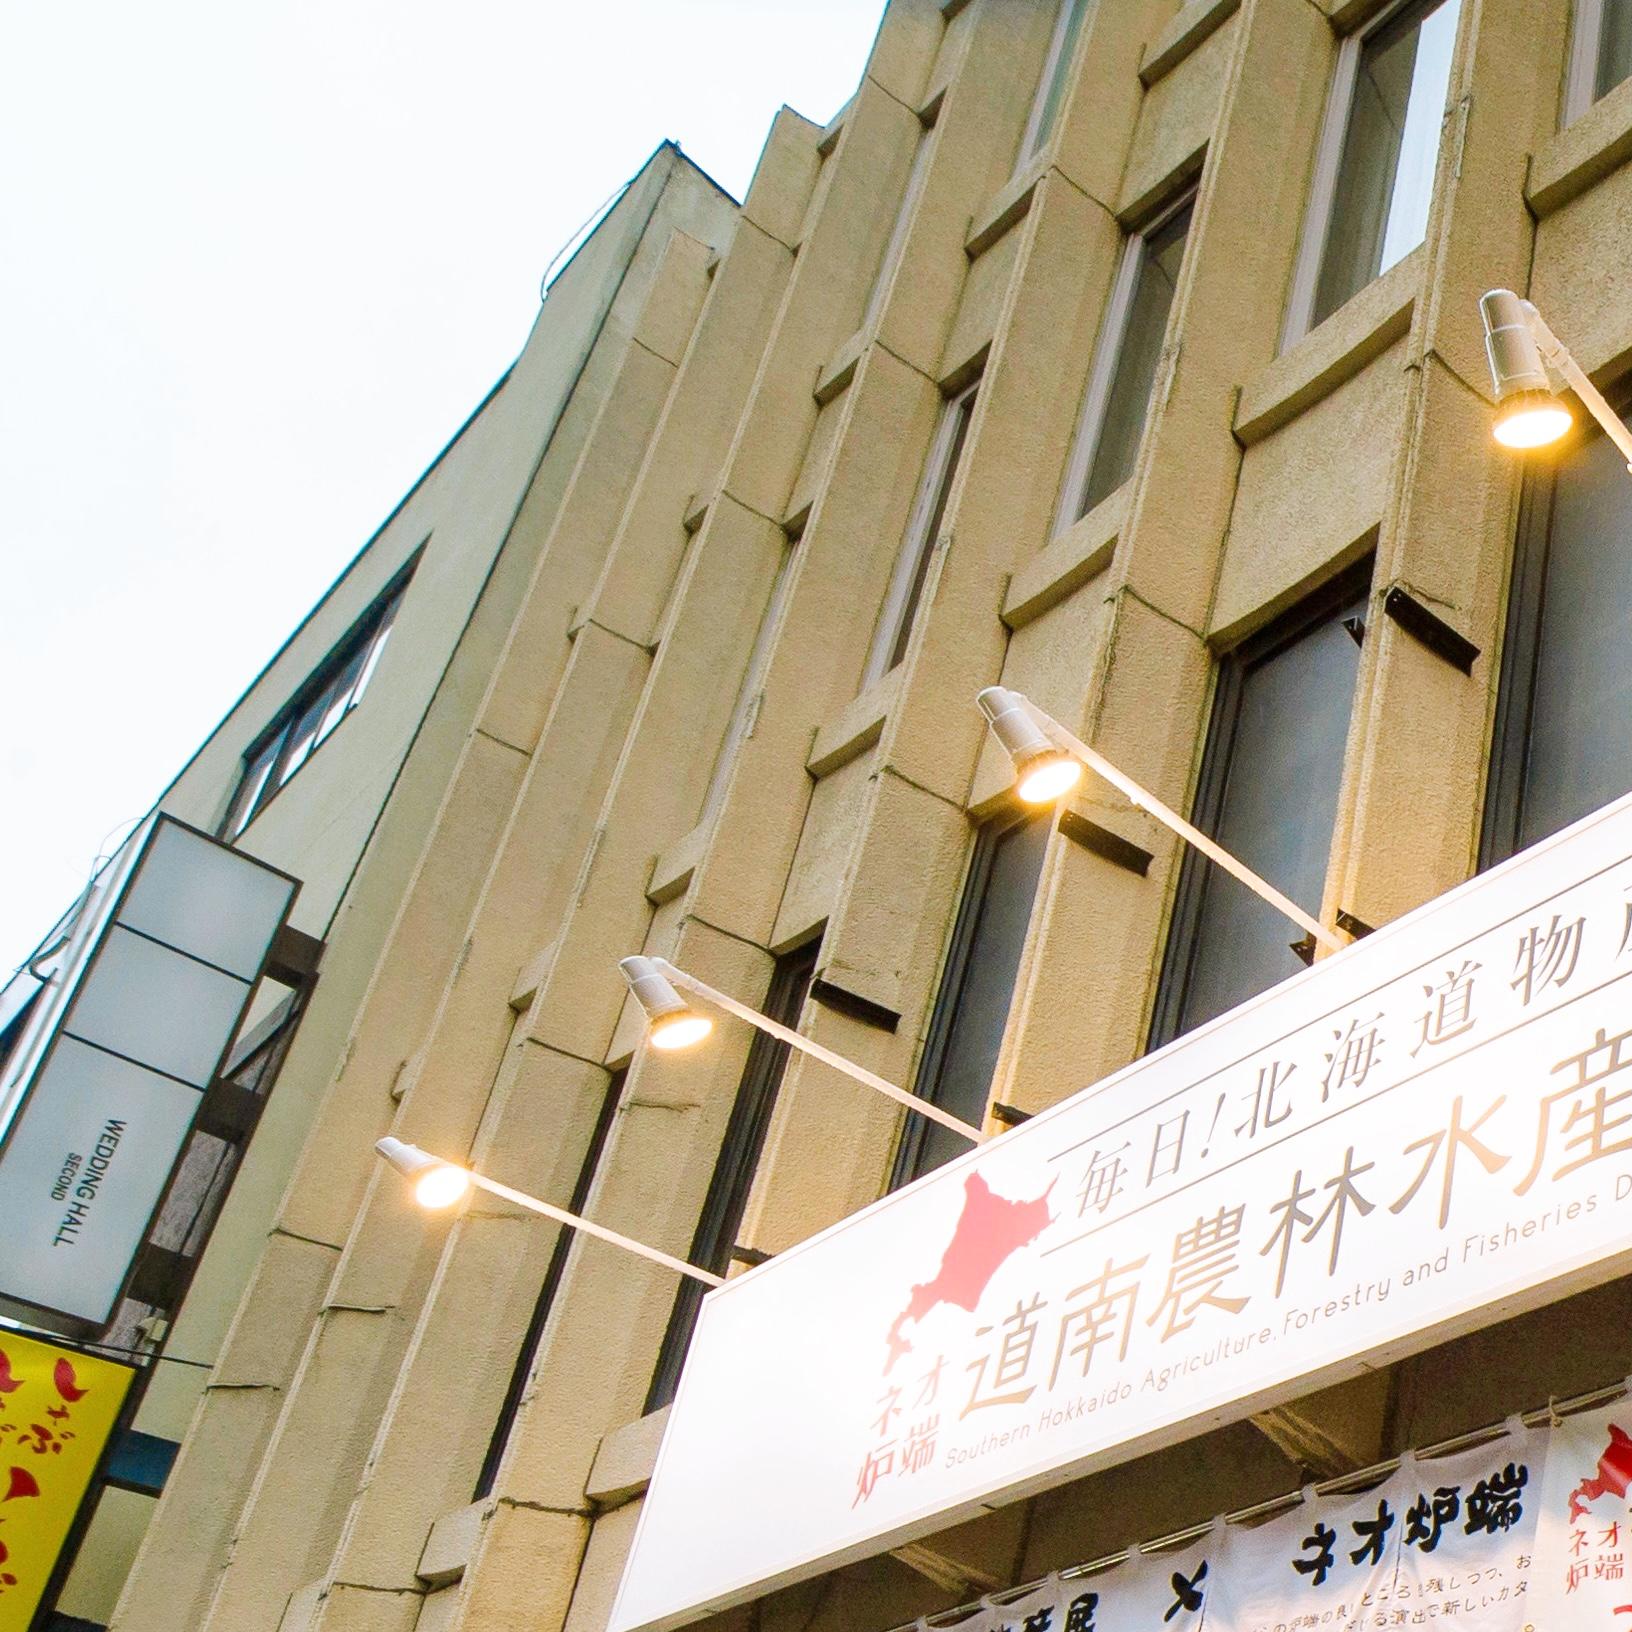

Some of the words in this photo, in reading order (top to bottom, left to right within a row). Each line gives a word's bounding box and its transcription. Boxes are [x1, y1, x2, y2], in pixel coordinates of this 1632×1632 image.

[51, 1152, 83, 1201] SECOND
[75, 1119, 128, 1201] WEDDING
[53, 1201, 91, 1247] HALL
[945, 1424, 1031, 1470] Southern
[1038, 1381, 1133, 1433] Hokkaido
[1282, 1277, 1391, 1337] Forestry
[1402, 1247, 1450, 1287] and
[1462, 1187, 1599, 1265] Fisheries
[1292, 1462, 1529, 1586] ネオ炉端
[1567, 1520, 1622, 1557] ネオ
[1565, 1553, 1625, 1595] 炉端
